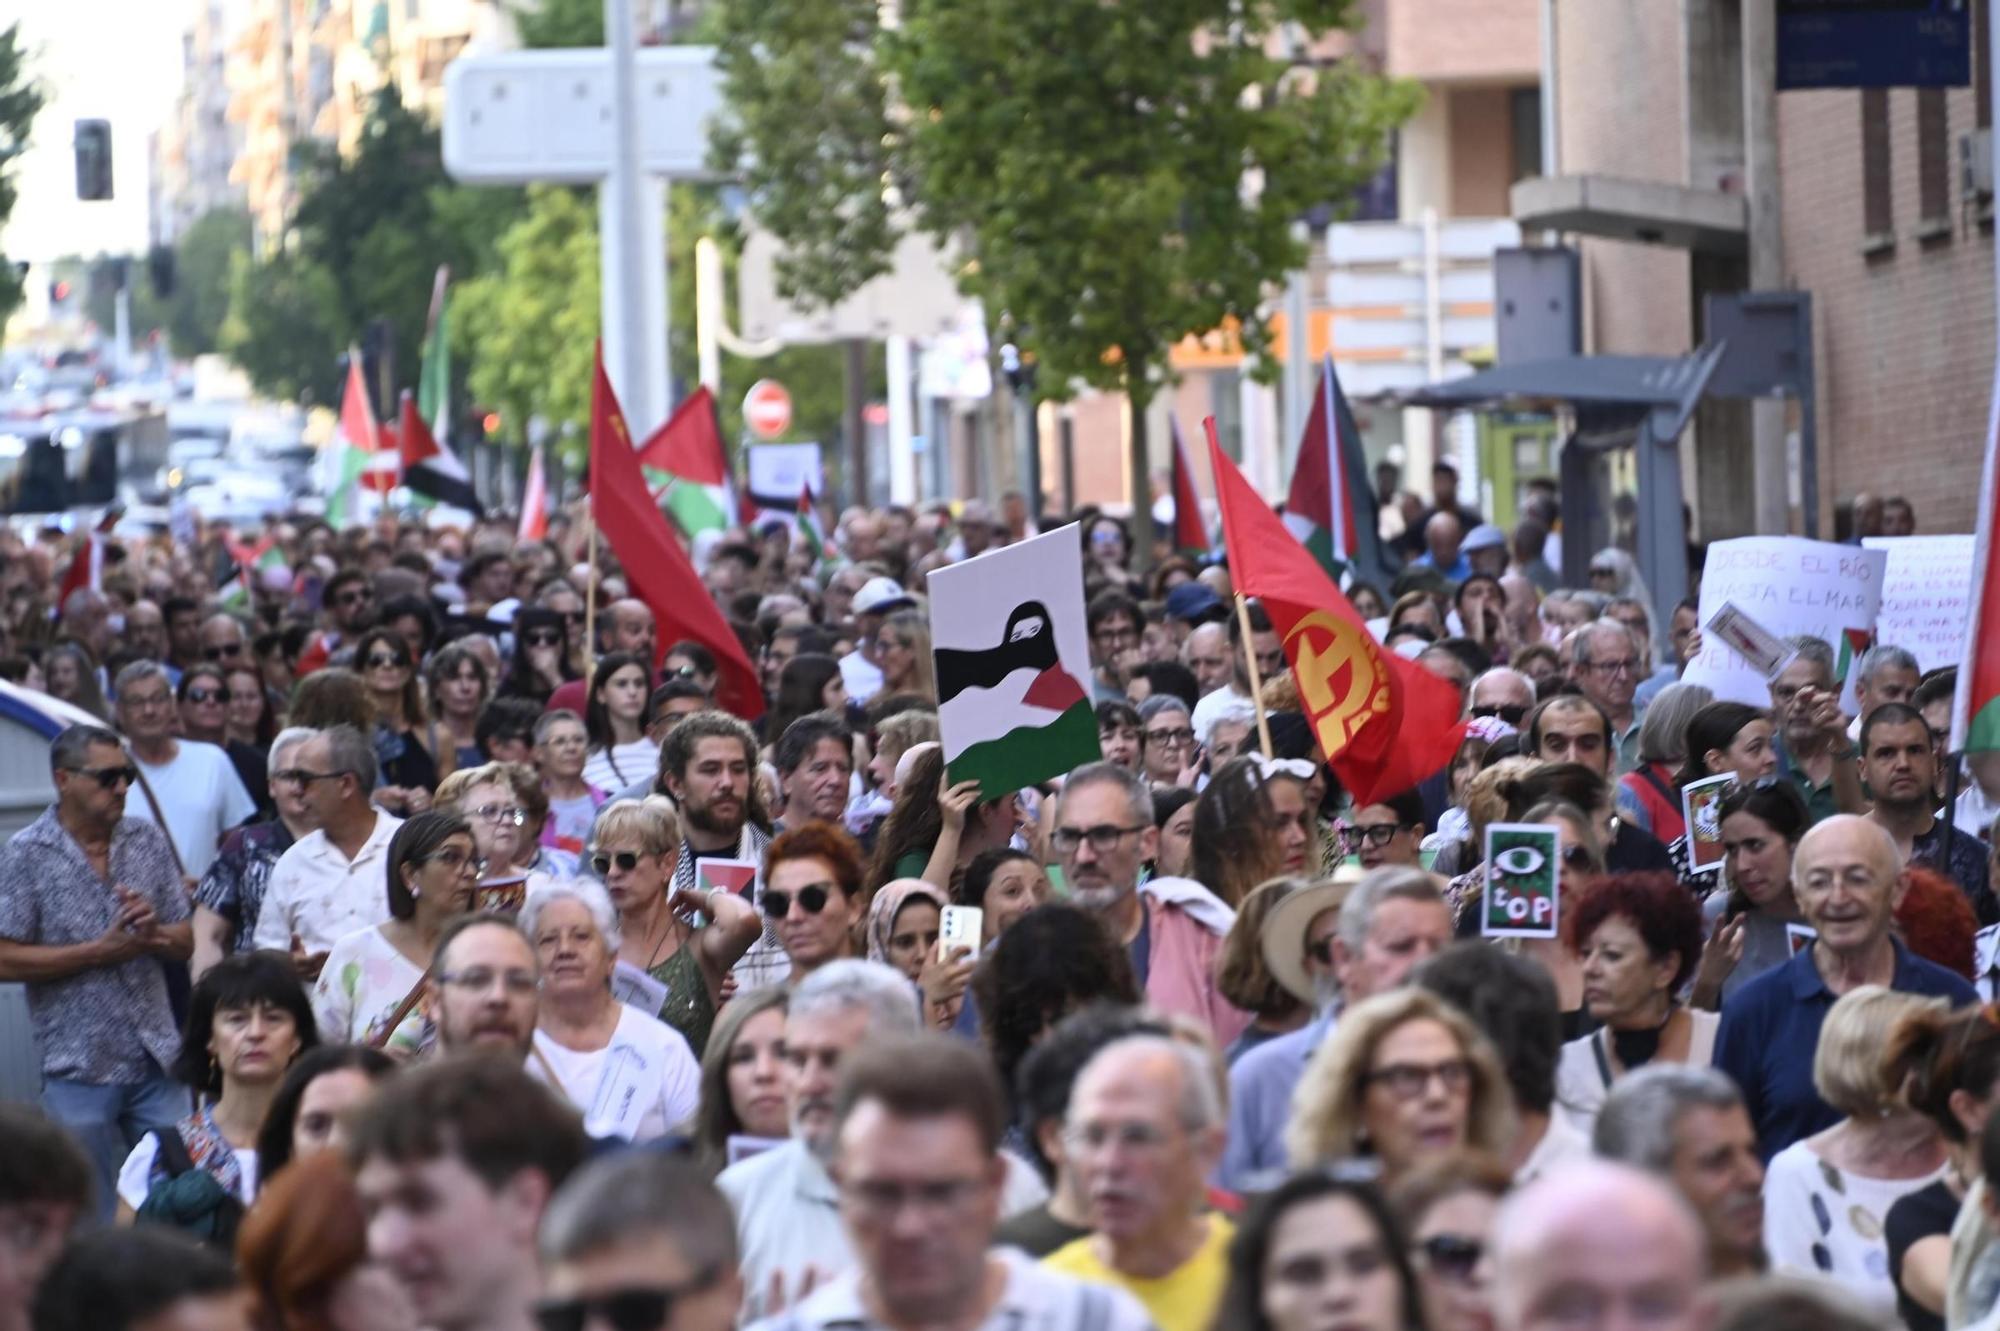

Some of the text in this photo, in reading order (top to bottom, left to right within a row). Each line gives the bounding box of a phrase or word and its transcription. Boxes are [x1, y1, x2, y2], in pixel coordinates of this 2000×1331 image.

[1714, 549, 1786, 573] DESDE
[1801, 554, 1831, 575] EL
[1708, 581, 1778, 603] HASTA
